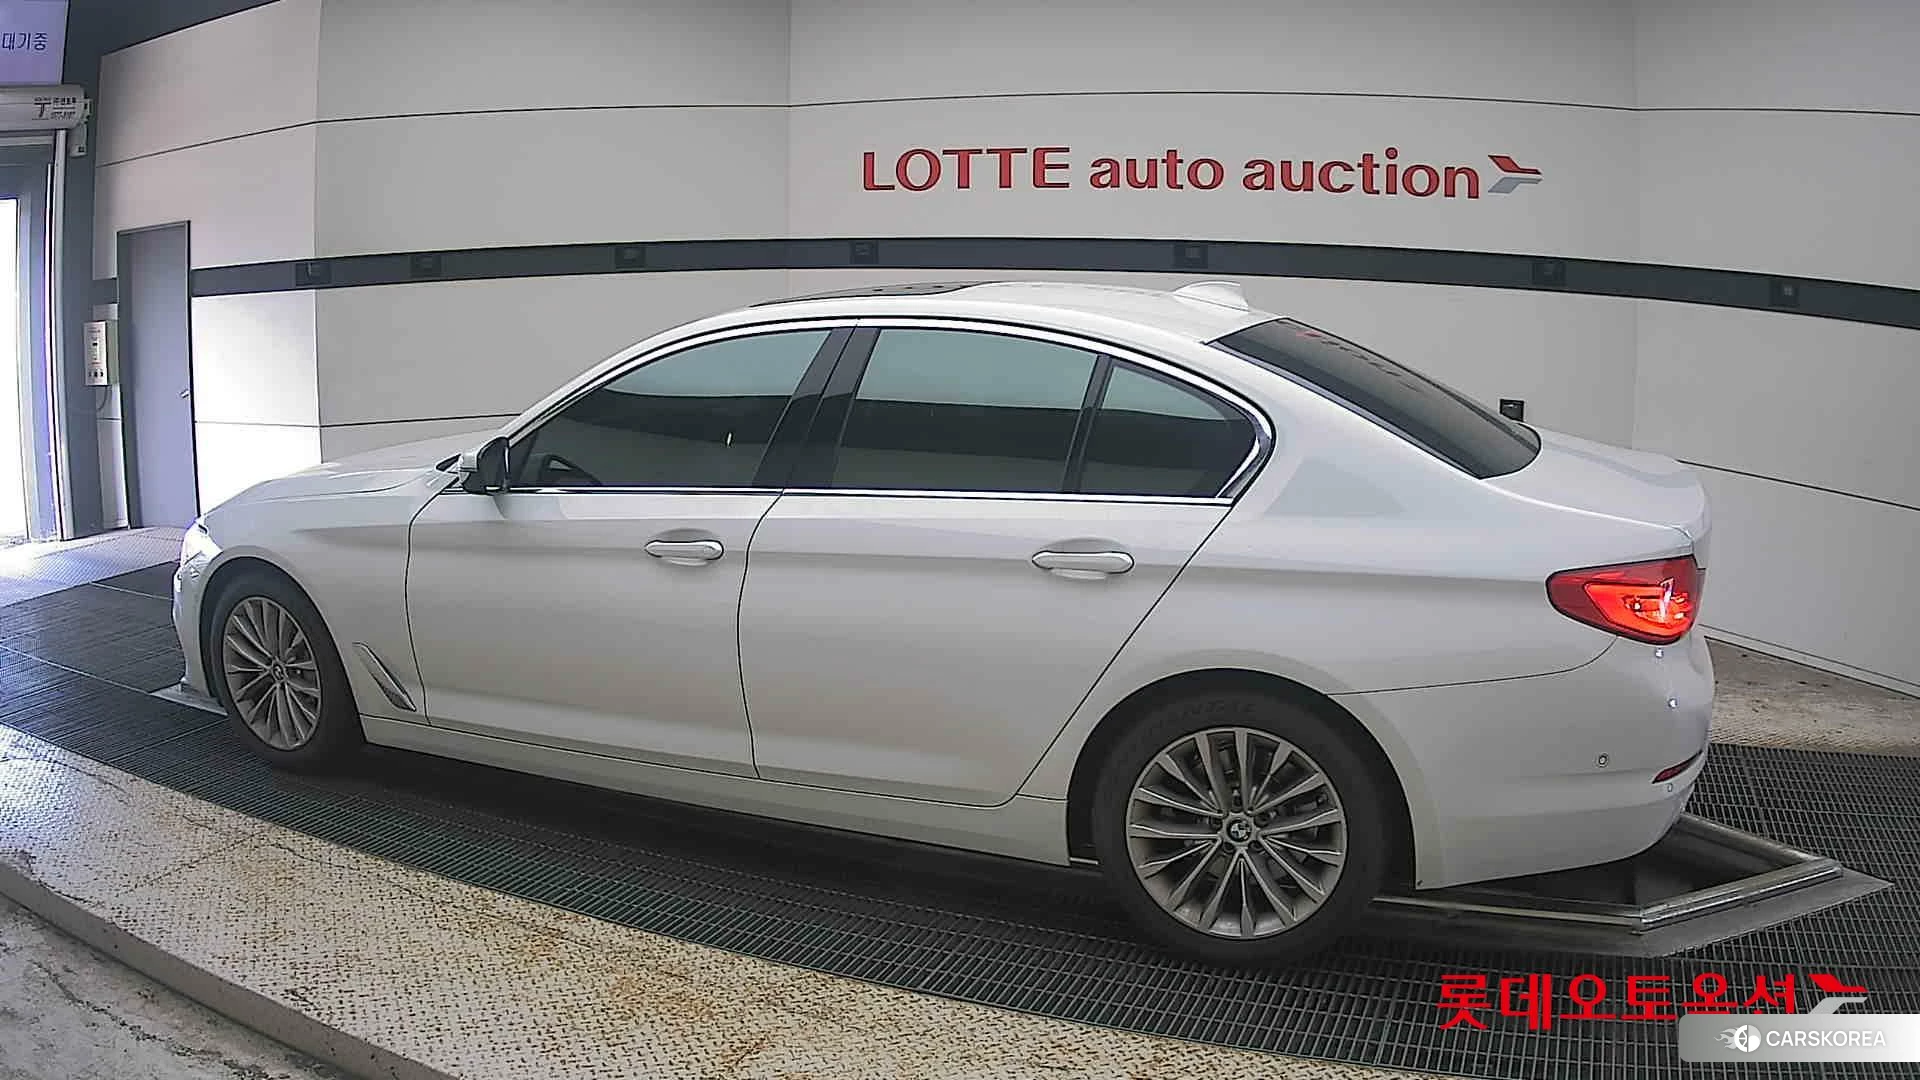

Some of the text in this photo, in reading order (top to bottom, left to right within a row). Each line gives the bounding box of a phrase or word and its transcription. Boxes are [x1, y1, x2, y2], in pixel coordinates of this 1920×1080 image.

[2, 31, 48, 50] 대기중
[863, 147, 1480, 199] LOTTE auto auction
